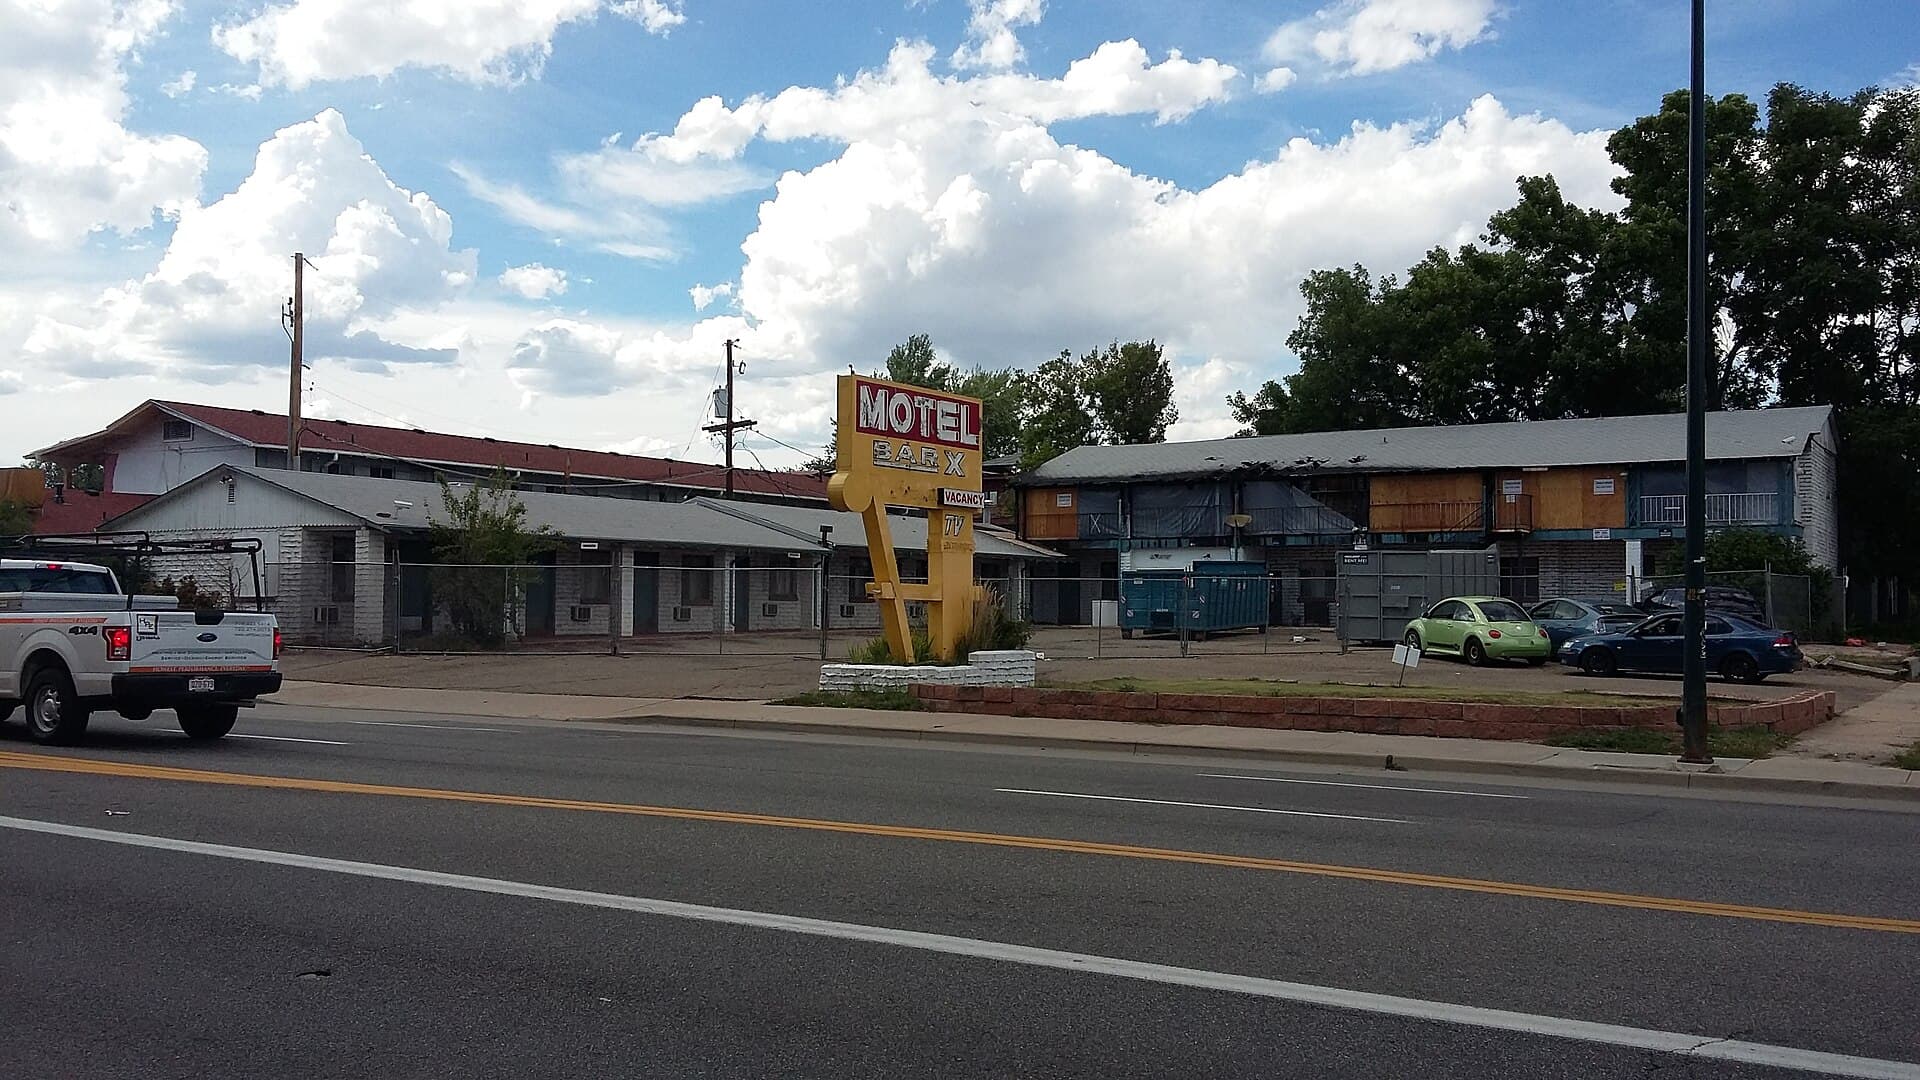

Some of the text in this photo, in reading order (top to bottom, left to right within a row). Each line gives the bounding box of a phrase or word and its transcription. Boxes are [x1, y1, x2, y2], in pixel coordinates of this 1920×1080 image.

[860, 385, 978, 445] MOTEL
[873, 440, 965, 477] BAR X
[945, 491, 984, 506] VACANCY
[944, 515, 965, 537] TV
